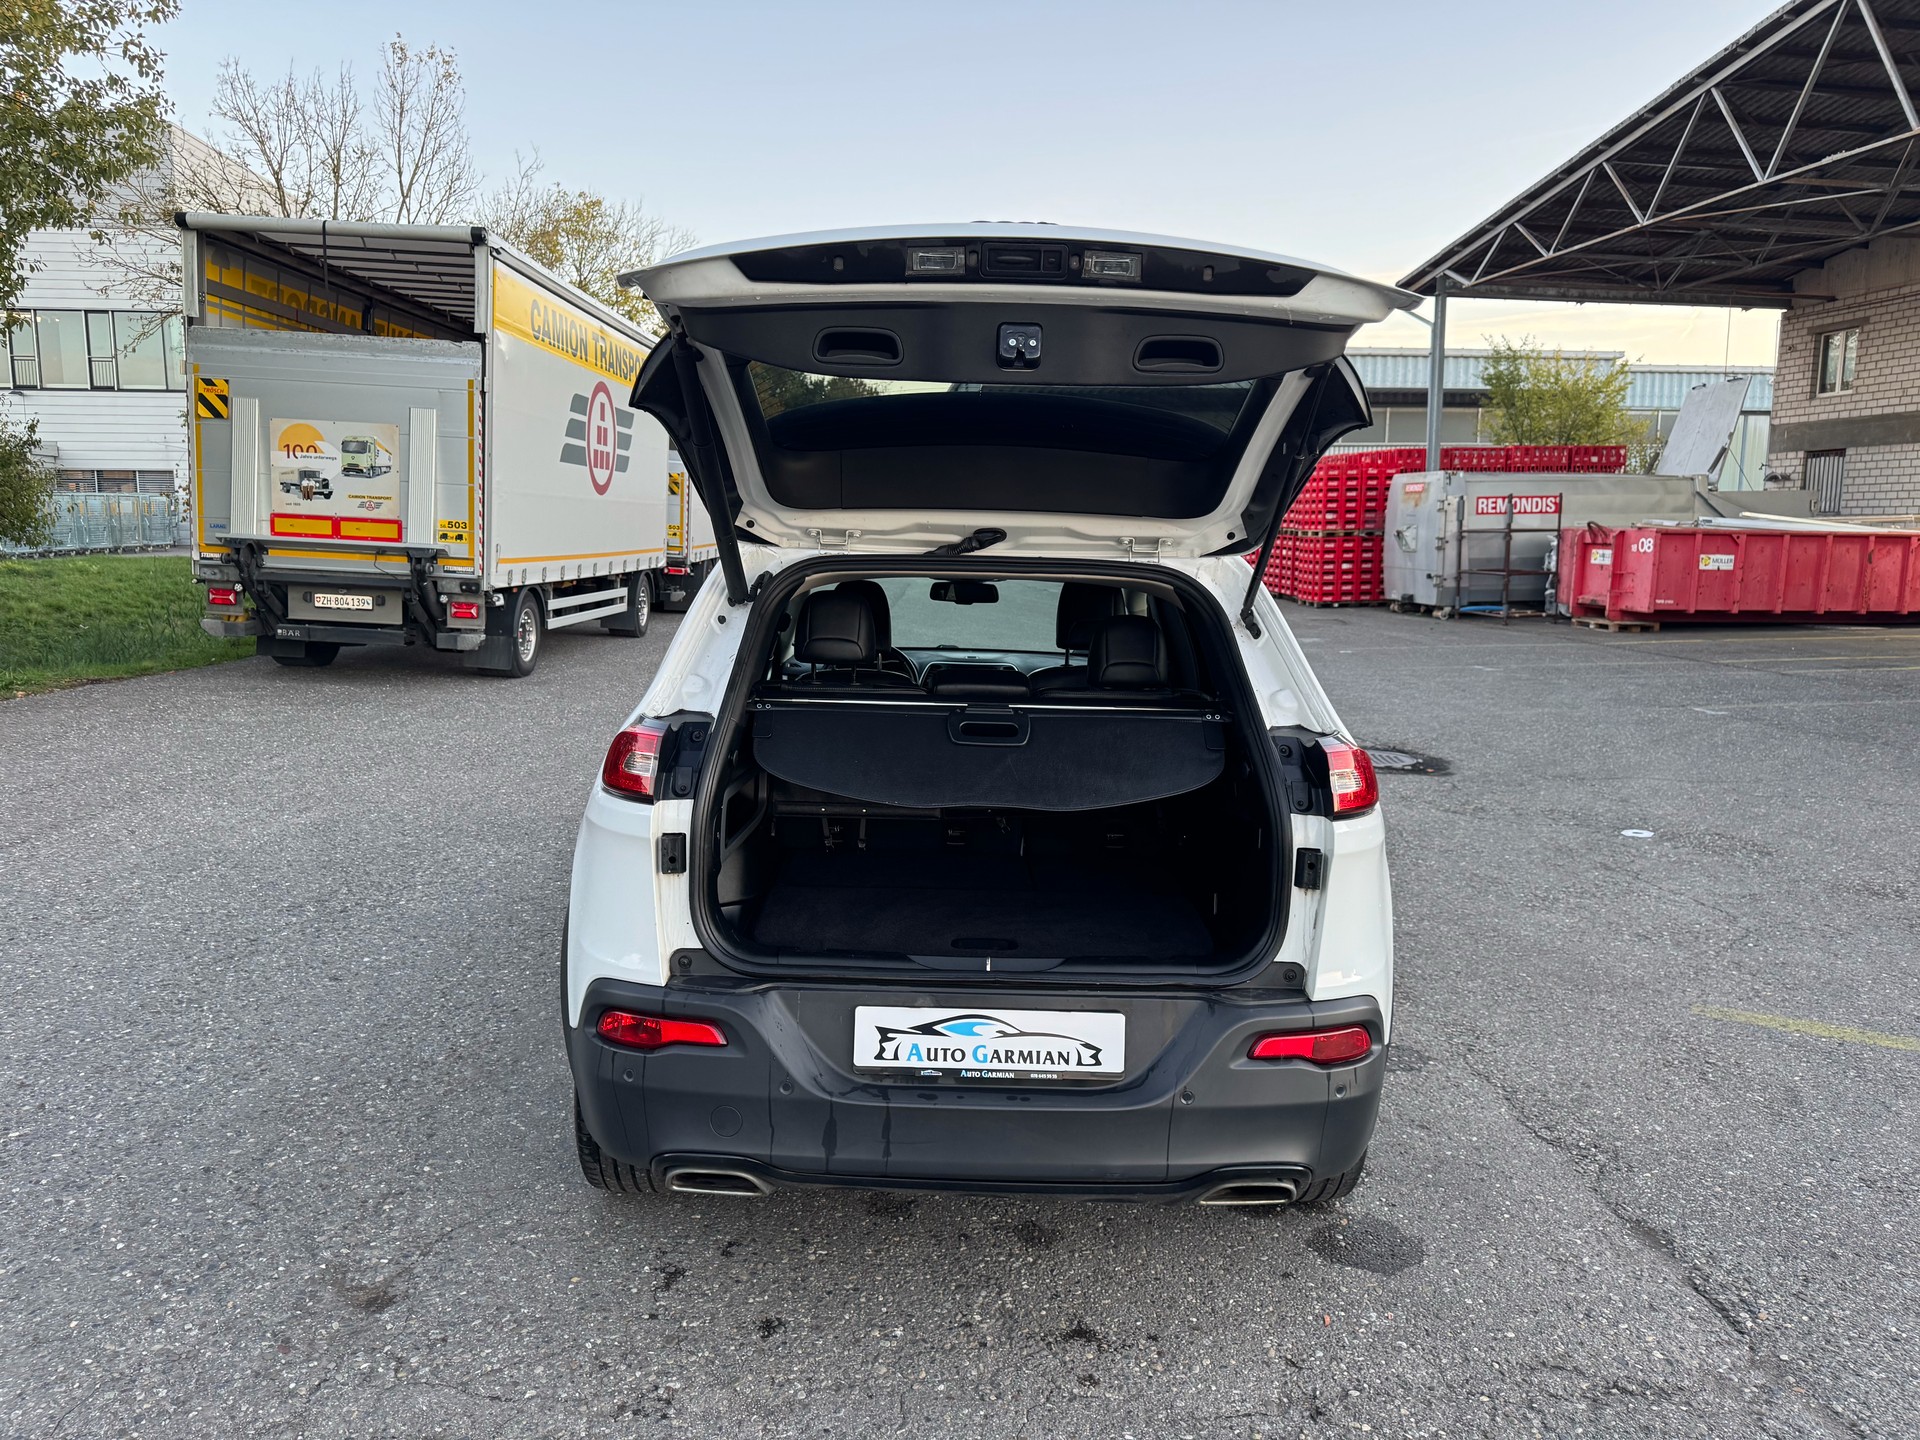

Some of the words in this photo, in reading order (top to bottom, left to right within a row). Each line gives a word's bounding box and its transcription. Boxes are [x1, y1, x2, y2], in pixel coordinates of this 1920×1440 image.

[530, 299, 589, 363] CAMION
[592, 332, 645, 382] TRANSPO
[447, 520, 468, 530] 503
[1638, 537, 1654, 553] 08
